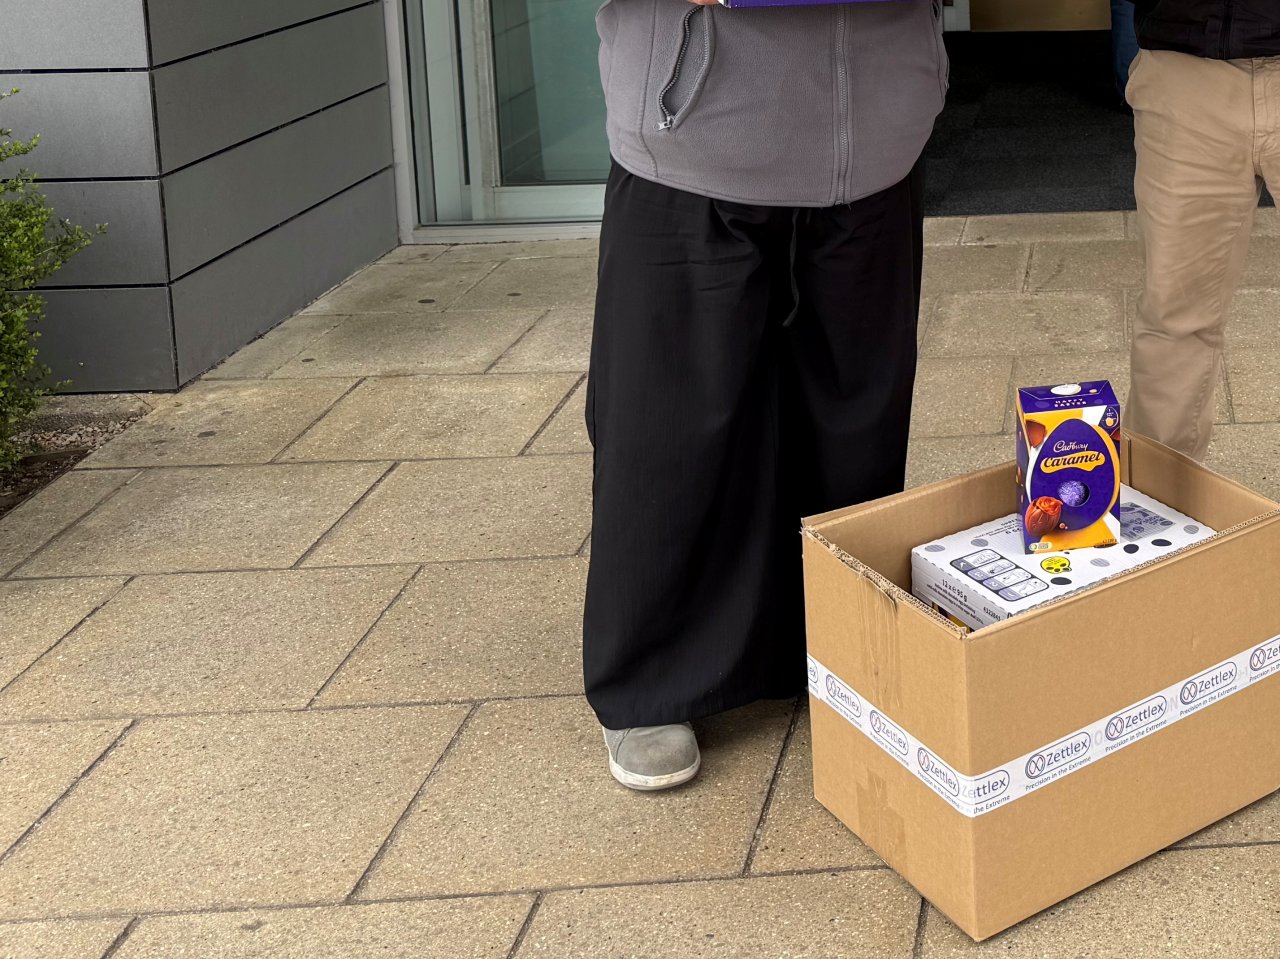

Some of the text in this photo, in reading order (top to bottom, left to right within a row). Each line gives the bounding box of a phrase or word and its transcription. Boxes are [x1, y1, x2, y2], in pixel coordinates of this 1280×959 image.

[1052, 439, 1089, 453] Cadbury
[1043, 451, 1102, 469] Caramel
[1198, 667, 1235, 694] Zettlex
[1249, 668, 1270, 682] Precision
[836, 686, 860, 713] Zettlex
[1179, 701, 1202, 716] Precision
[1208, 694, 1217, 703] the
[1217, 684, 1238, 699] Extreme
[1125, 701, 1164, 729] Zettlex
[881, 723, 907, 750] Zettlex
[1105, 737, 1129, 752] Precision
[1135, 728, 1145, 738] the
[1145, 719, 1167, 734] Extreme
[1046, 739, 1088, 767] Zettlex
[929, 760, 957, 791] Zettlex
[1025, 776, 1051, 792] Precision
[1058, 768, 1068, 776] the
[1068, 756, 1092, 771] Extreme
[985, 795, 1011, 810] Extreme
